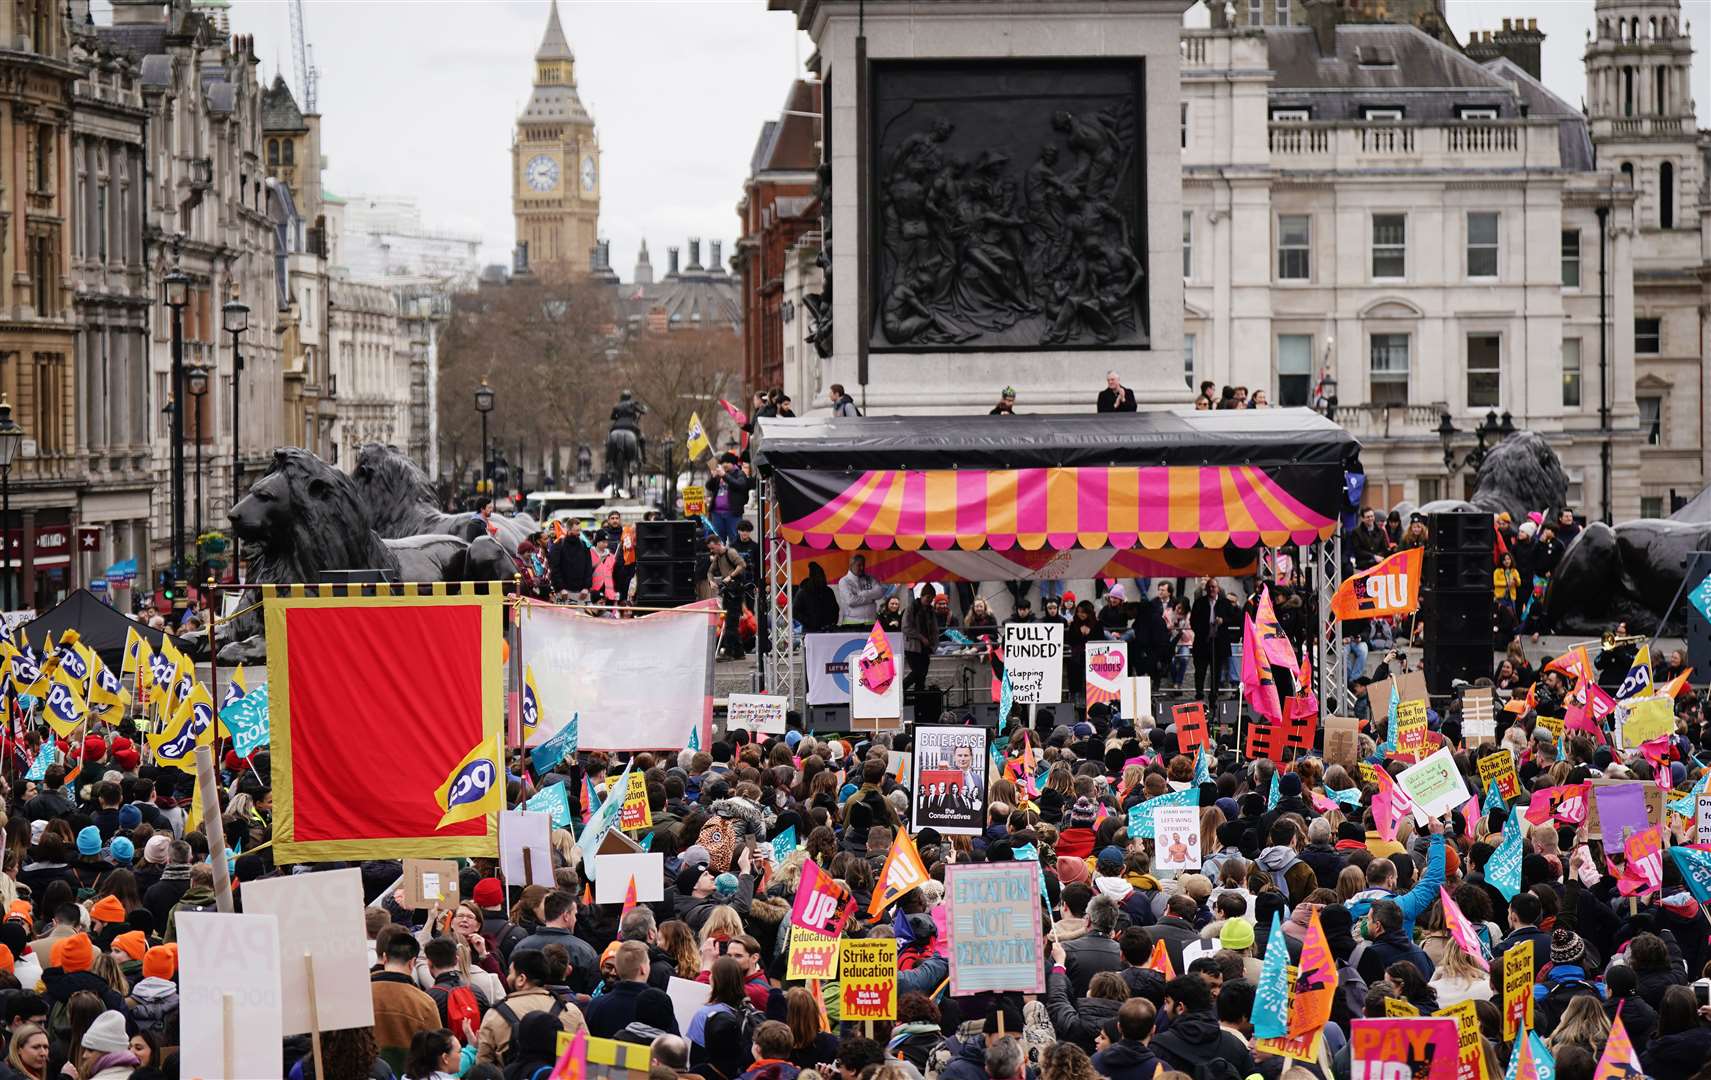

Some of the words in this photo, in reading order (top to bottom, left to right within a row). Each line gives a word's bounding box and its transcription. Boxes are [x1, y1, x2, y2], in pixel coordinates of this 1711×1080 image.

[1006, 626, 1055, 641] FULLY
[11, 660, 42, 680] pcs
[1009, 668, 1044, 680] clapping
[1088, 663, 1121, 672] SCHOOLS
[1012, 691, 1040, 703] ount!
[523, 696, 537, 724] cs
[1414, 706, 1424, 714] for
[920, 733, 985, 748] BRIEFCASE
[1480, 761, 1500, 774] Strike
[1500, 757, 1510, 765] for
[632, 780, 642, 789] for
[928, 811, 971, 820] Conservatives
[802, 890, 838, 929] UP
[975, 907, 1013, 937] NOT
[843, 950, 875, 963] Strike
[878, 950, 894, 963] for
[843, 964, 894, 977] education
[1462, 1014, 1474, 1029] for
[1353, 1027, 1434, 1063] PAY
